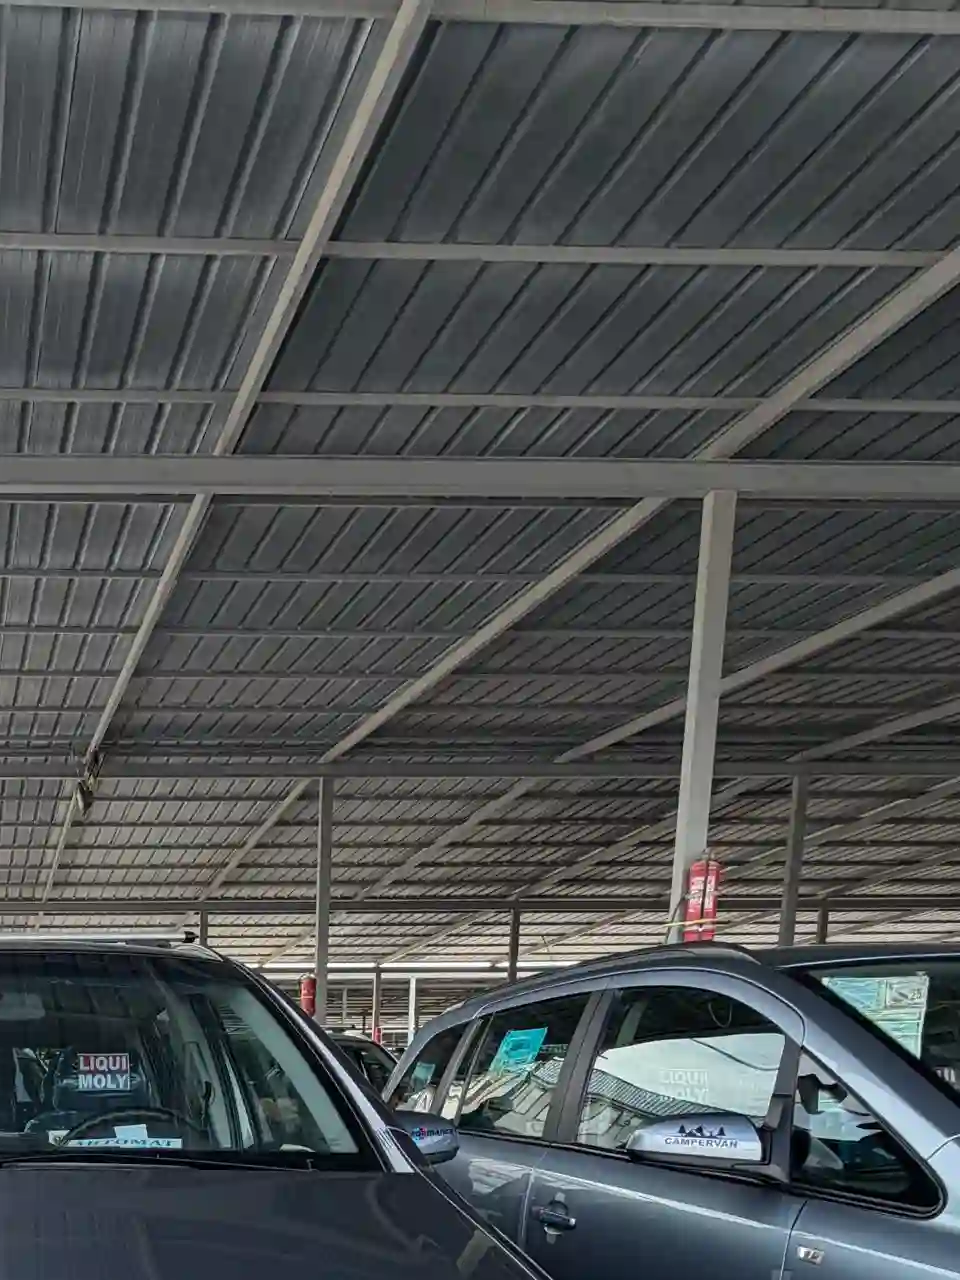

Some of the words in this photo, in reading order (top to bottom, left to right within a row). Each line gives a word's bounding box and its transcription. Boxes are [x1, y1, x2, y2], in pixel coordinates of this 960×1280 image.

[79, 1056, 128, 1072] LIQUI
[79, 1074, 127, 1089] MOLY
[664, 1137, 739, 1149] CAMPERVAN
